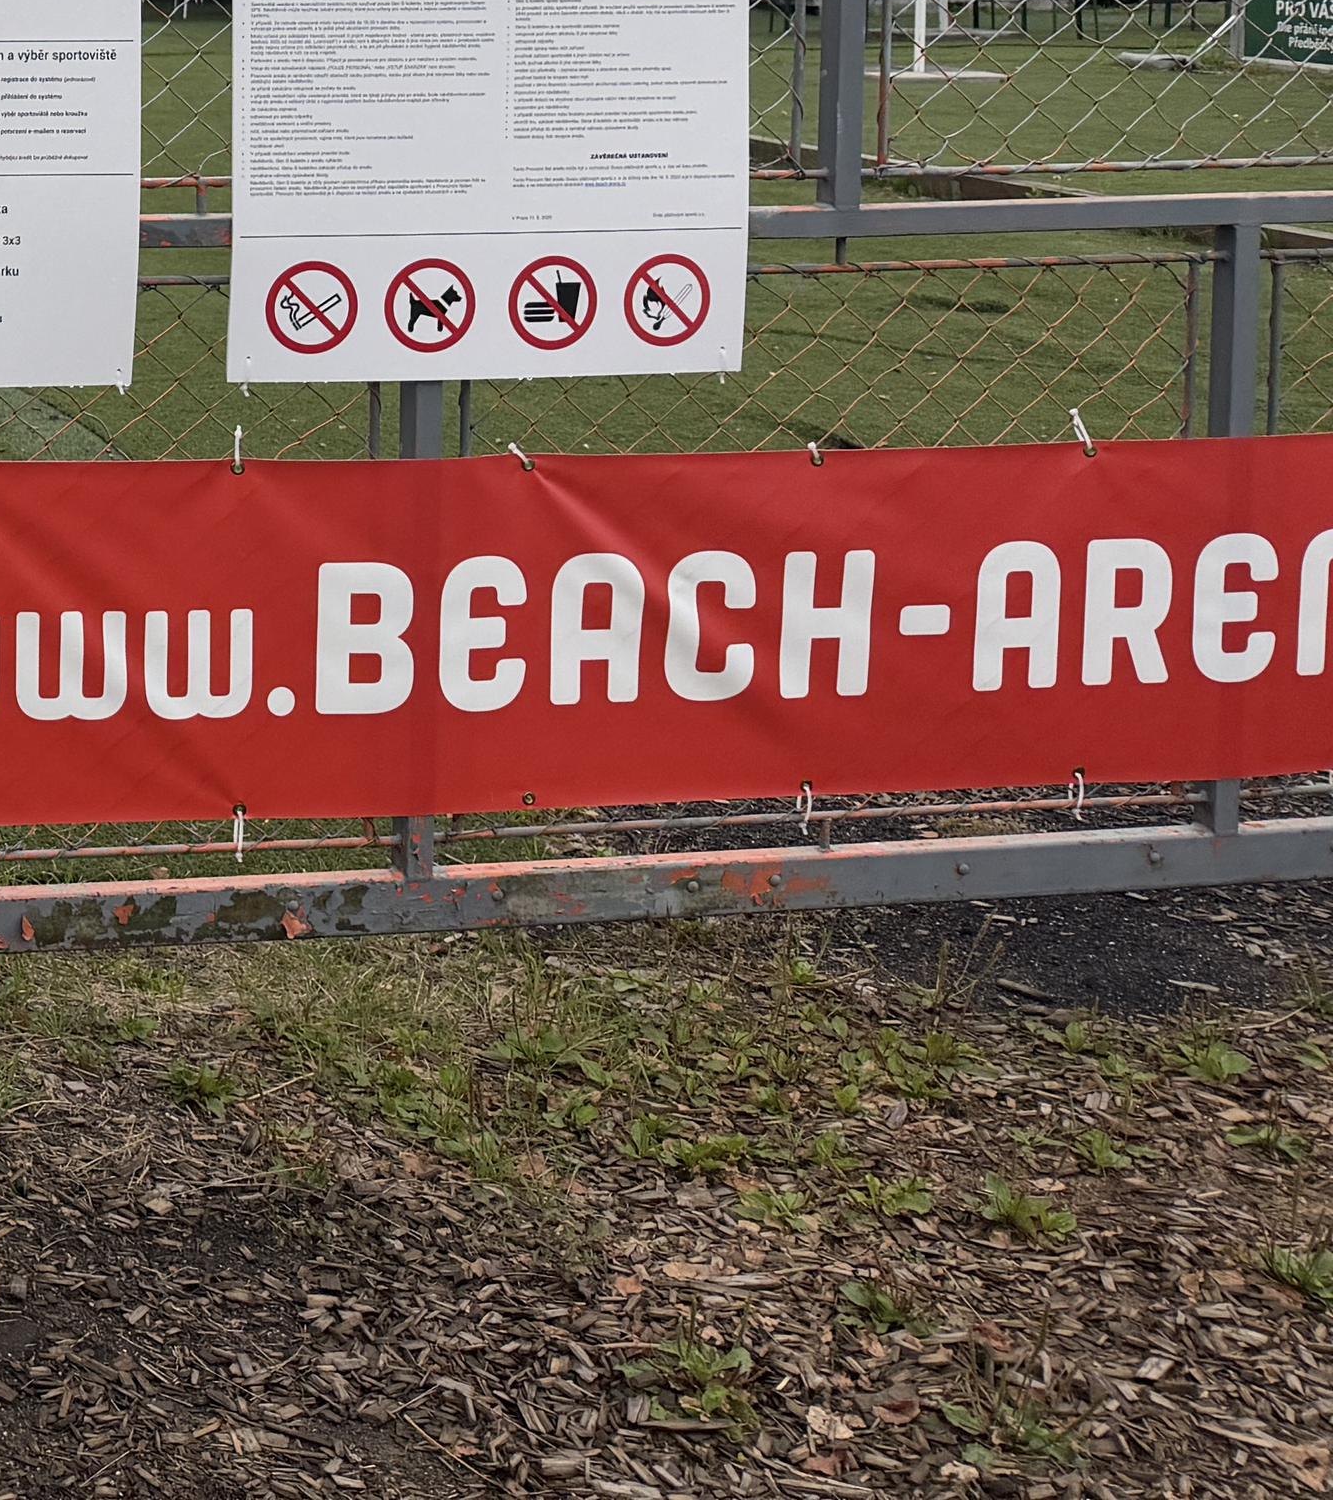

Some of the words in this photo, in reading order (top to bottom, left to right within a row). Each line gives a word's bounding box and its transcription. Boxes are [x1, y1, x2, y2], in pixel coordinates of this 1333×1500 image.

[7, 52, 15, 60] a
[17, 50, 49, 63] výběr
[51, 49, 117, 63] sportoviště
